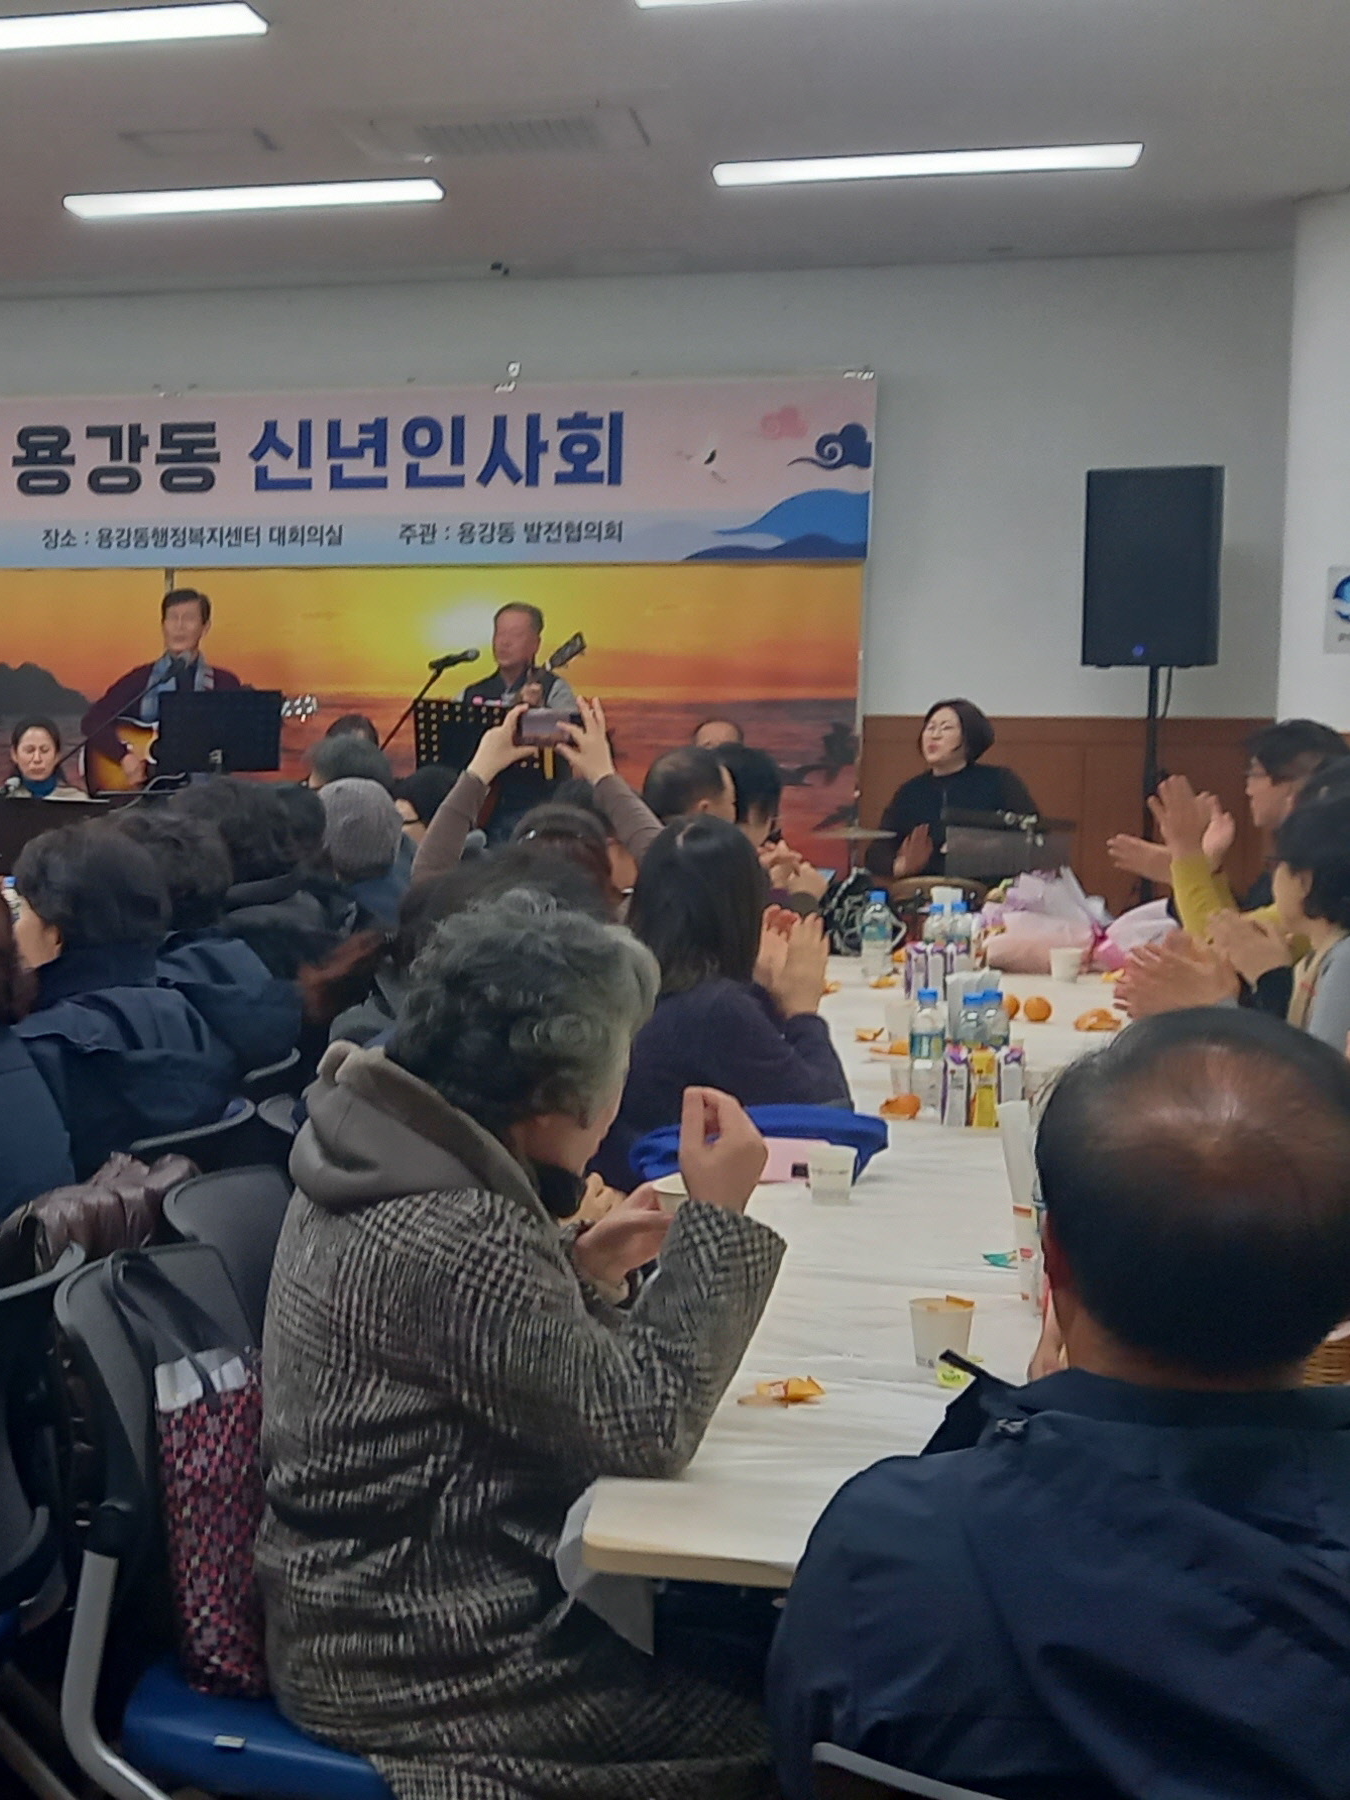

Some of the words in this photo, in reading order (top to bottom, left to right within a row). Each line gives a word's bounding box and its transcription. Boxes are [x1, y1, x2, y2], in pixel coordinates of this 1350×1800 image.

[11, 420, 221, 496] 용강동
[248, 410, 625, 492] 신년인사회
[42, 528, 78, 549] 장소
[268, 524, 344, 547] 대회의실
[399, 522, 438, 546] 주관
[457, 521, 515, 545] 용강동
[523, 520, 624, 544] 발전협의회
